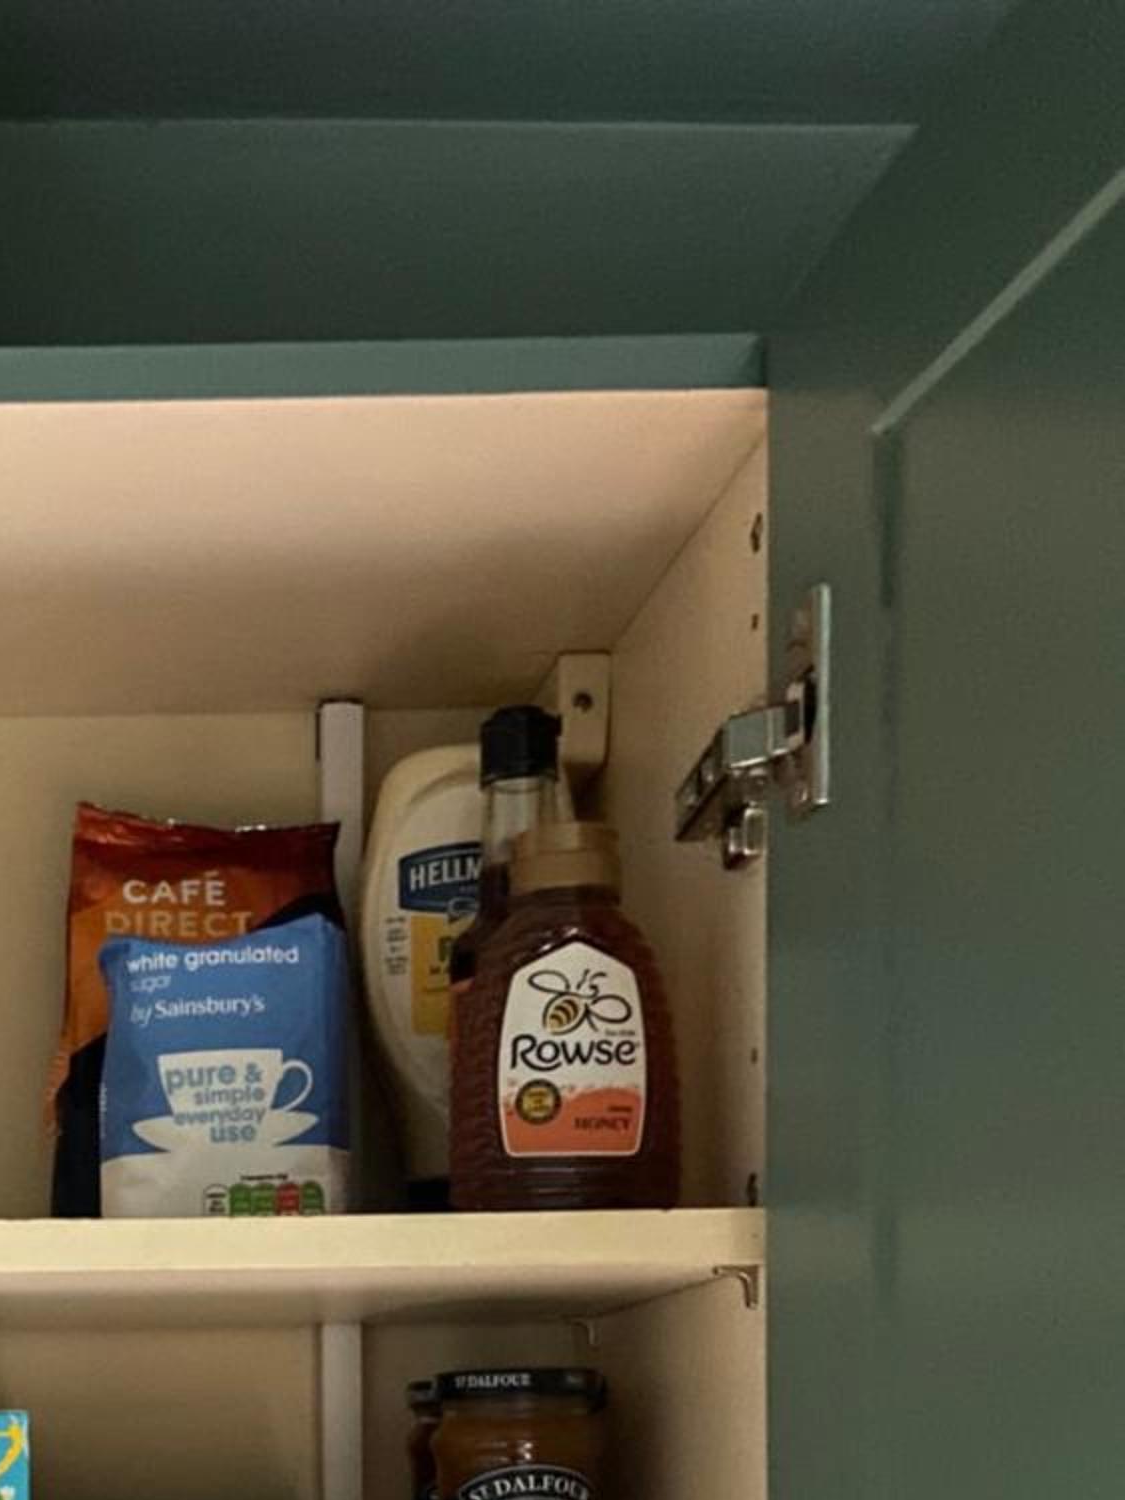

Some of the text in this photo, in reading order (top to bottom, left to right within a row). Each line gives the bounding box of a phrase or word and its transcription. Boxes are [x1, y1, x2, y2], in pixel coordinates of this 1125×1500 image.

[123, 871, 226, 907] CAFÉ
[105, 911, 254, 938] DIRECT
[127, 946, 300, 973] white granulated
[130, 974, 172, 993] sugar
[131, 994, 266, 1026] by Sainsbury's
[510, 1034, 636, 1072] Rowse
[165, 1063, 263, 1095] pure &
[194, 1083, 266, 1106] simple
[174, 1106, 267, 1128] everyday
[210, 1124, 257, 1144] use
